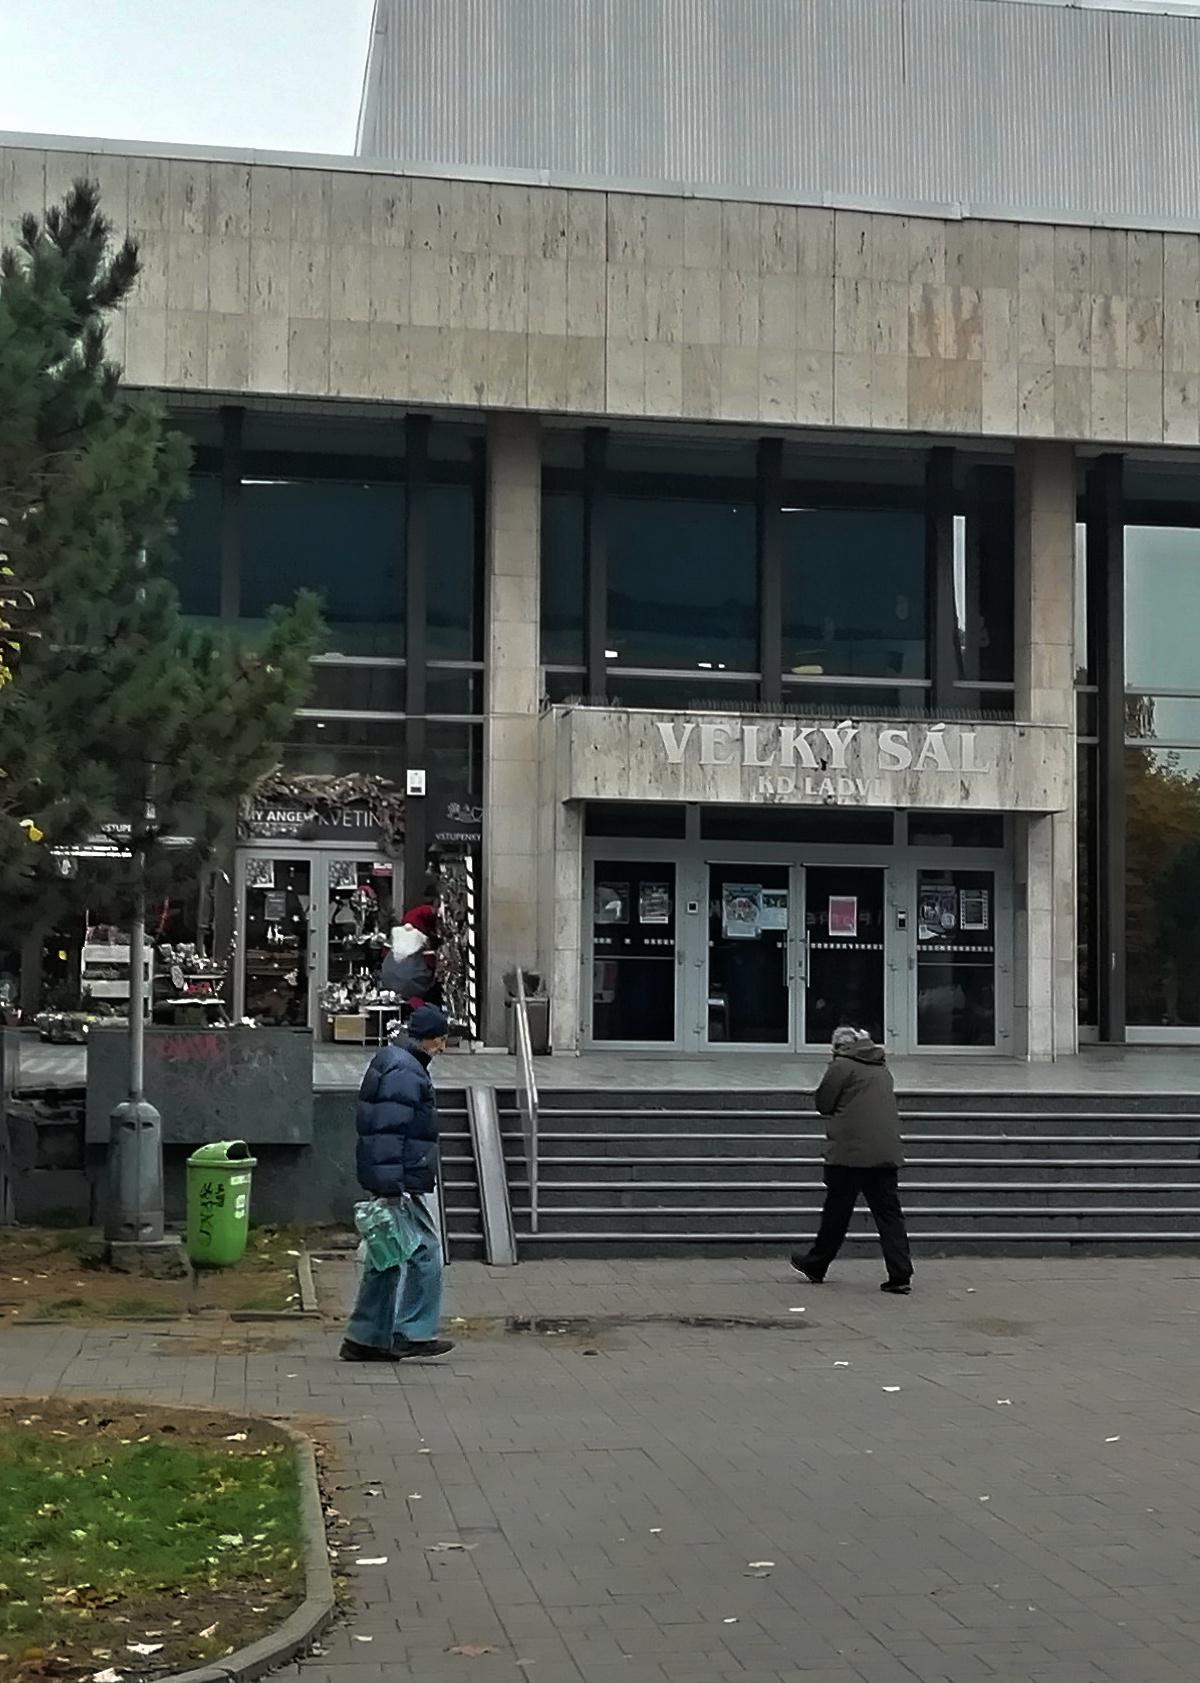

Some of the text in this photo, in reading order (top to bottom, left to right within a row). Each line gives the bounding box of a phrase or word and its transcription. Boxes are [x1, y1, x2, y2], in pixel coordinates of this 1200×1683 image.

[657, 719, 991, 773] VELKÝ SÁL
[759, 775, 795, 794] KD
